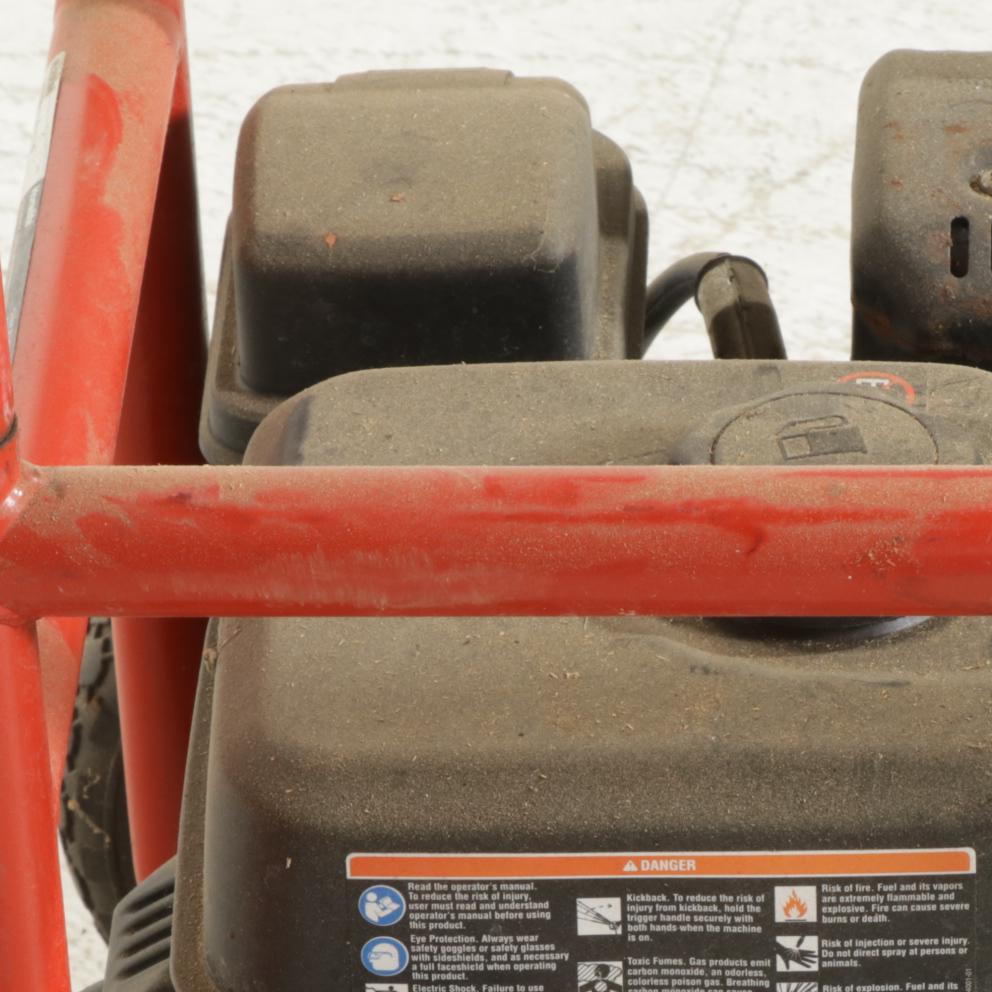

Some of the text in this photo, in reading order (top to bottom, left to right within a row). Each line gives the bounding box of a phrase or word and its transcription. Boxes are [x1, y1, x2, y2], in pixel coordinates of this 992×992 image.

[641, 859, 697, 872] DANGER
[407, 883, 432, 891] Read
[433, 883, 448, 891] the
[451, 883, 498, 893] operator's
[821, 884, 842, 892] Risk
[843, 884, 853, 892] of
[877, 883, 897, 892] Fuel
[899, 883, 917, 891] and
[919, 883, 930, 891] its
[932, 884, 963, 892] vapors
[408, 892, 419, 900] To
[421, 892, 452, 900] reduce
[454, 892, 469, 900] the
[471, 892, 489, 900] risk
[491, 892, 500, 900] of
[673, 894, 684, 902] To
[686, 894, 717, 902] reduce
[719, 894, 734, 902] the
[736, 894, 753, 902] risk
[755, 894, 765, 903] of
[839, 893, 885, 904] extremely
[886, 893, 936, 902] flammable
[938, 892, 955, 901] and
[431, 902, 454, 910] must
[456, 902, 477, 910] read
[479, 901, 496, 910] and
[498, 901, 549, 910] understand
[626, 903, 653, 913] injury
[655, 904, 677, 912] from
[724, 904, 744, 912] hold
[746, 904, 762, 913] the
[871, 904, 889, 912] Fire
[409, 910, 551, 921] operator's manual before using
[626, 913, 754, 924] trigger handle securely with
[821, 915, 848, 924] burns
[409, 921, 426, 929] this
[627, 923, 762, 933] both hands when the machine
[627, 933, 636, 942] is
[821, 939, 842, 948] Risk
[843, 939, 853, 947] of
[855, 938, 895, 949] injection
[821, 949, 834, 958] Do
[836, 949, 851, 957] not
[853, 948, 880, 957] direct
[881, 949, 907, 958] spray
[909, 947, 918, 956] at
[920, 948, 956, 957] persons
[627, 957, 651, 966] Toxic
[689, 958, 707, 966] Gas
[709, 958, 748, 968] products
[750, 959, 771, 967] emit
[627, 967, 659, 976] carbon
[627, 977, 669, 986] colorless
[671, 978, 702, 988] poison
[726, 978, 770, 988] Breathing
[822, 984, 842, 992] Risk
[844, 984, 854, 992] of
[905, 983, 926, 991] Fuel
[928, 982, 945, 991] and
[947, 982, 959, 990] its
